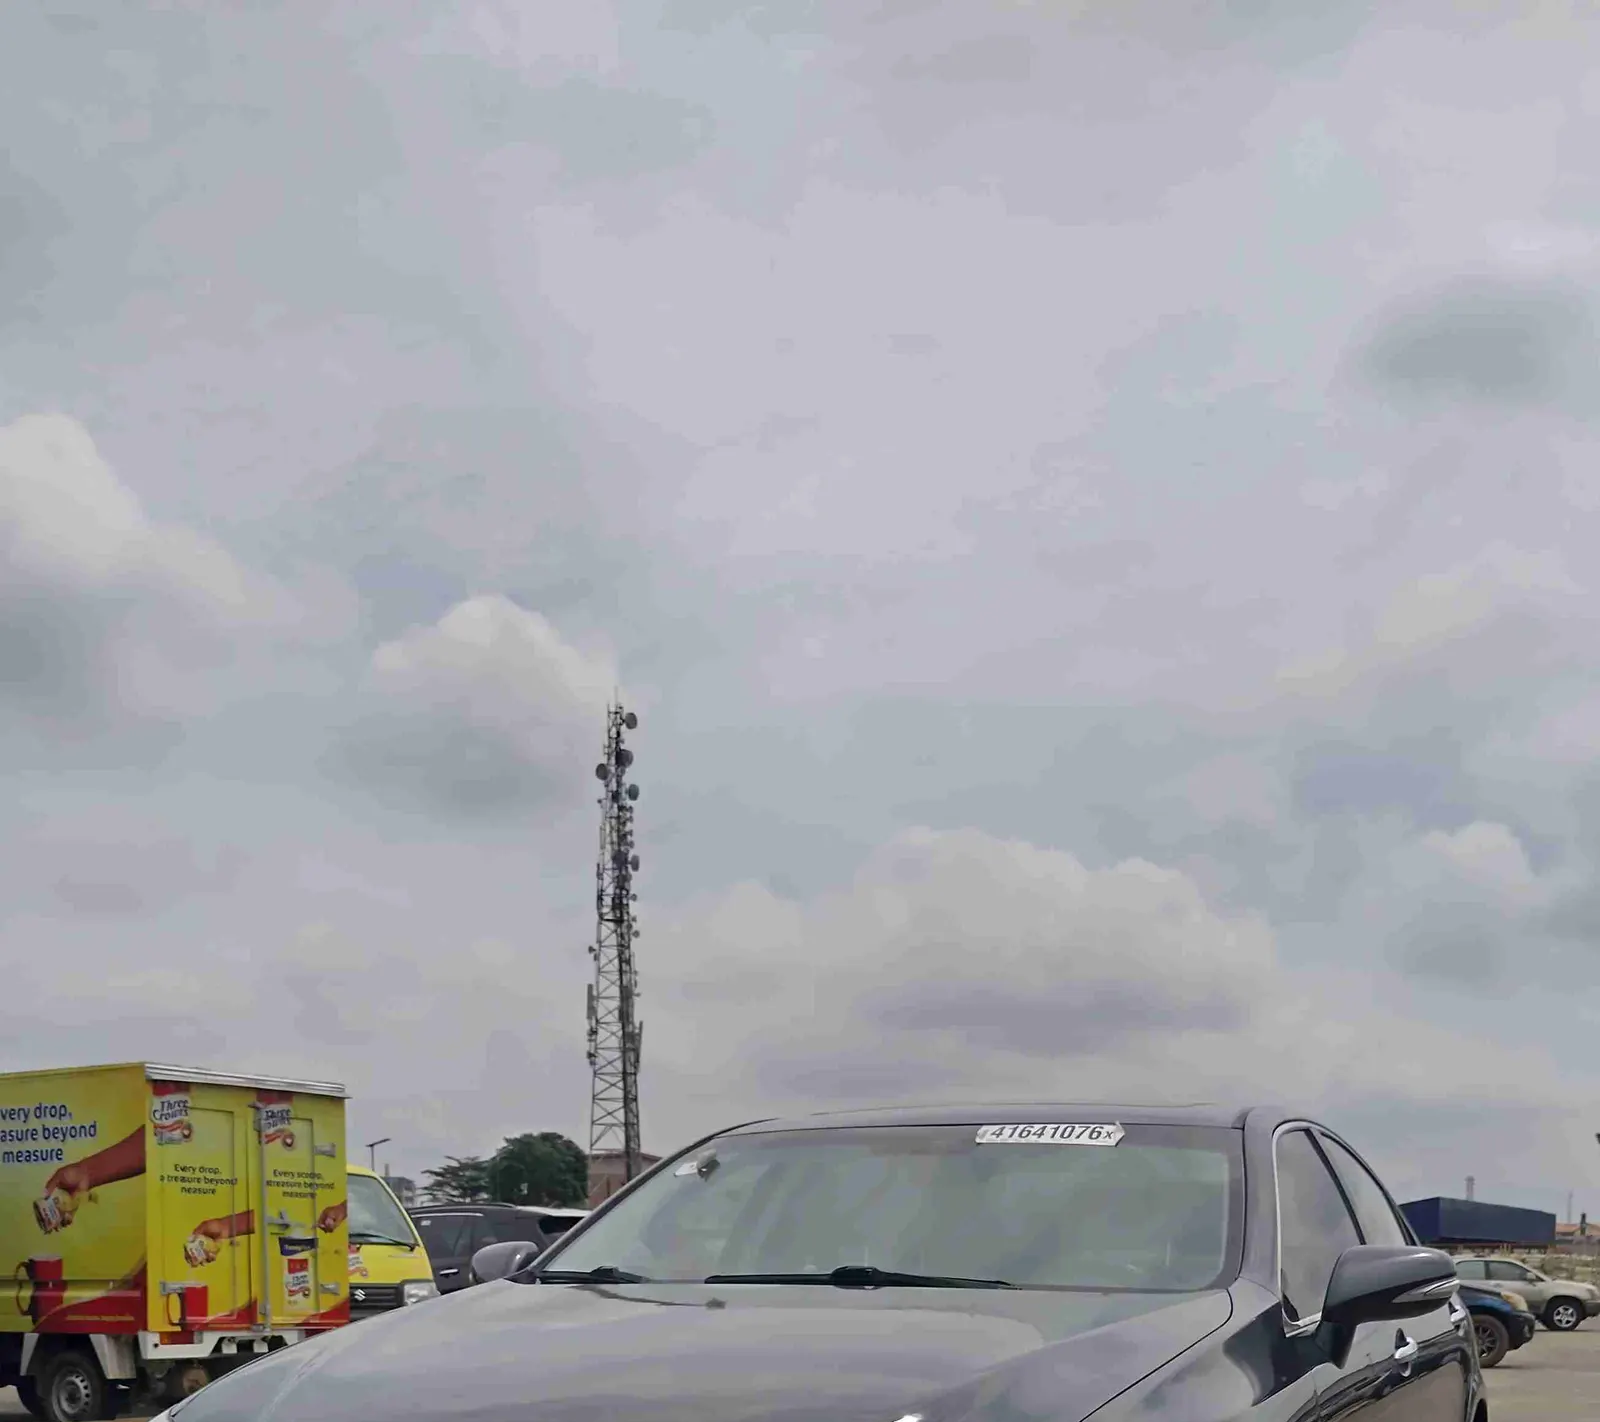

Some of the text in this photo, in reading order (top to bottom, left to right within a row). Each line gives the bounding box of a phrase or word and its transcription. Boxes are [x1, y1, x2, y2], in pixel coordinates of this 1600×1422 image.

[42, 1120, 97, 1142] beyond
[3, 1148, 63, 1163] measure
[174, 1163, 196, 1174] Every
[273, 1169, 295, 1179] Every
